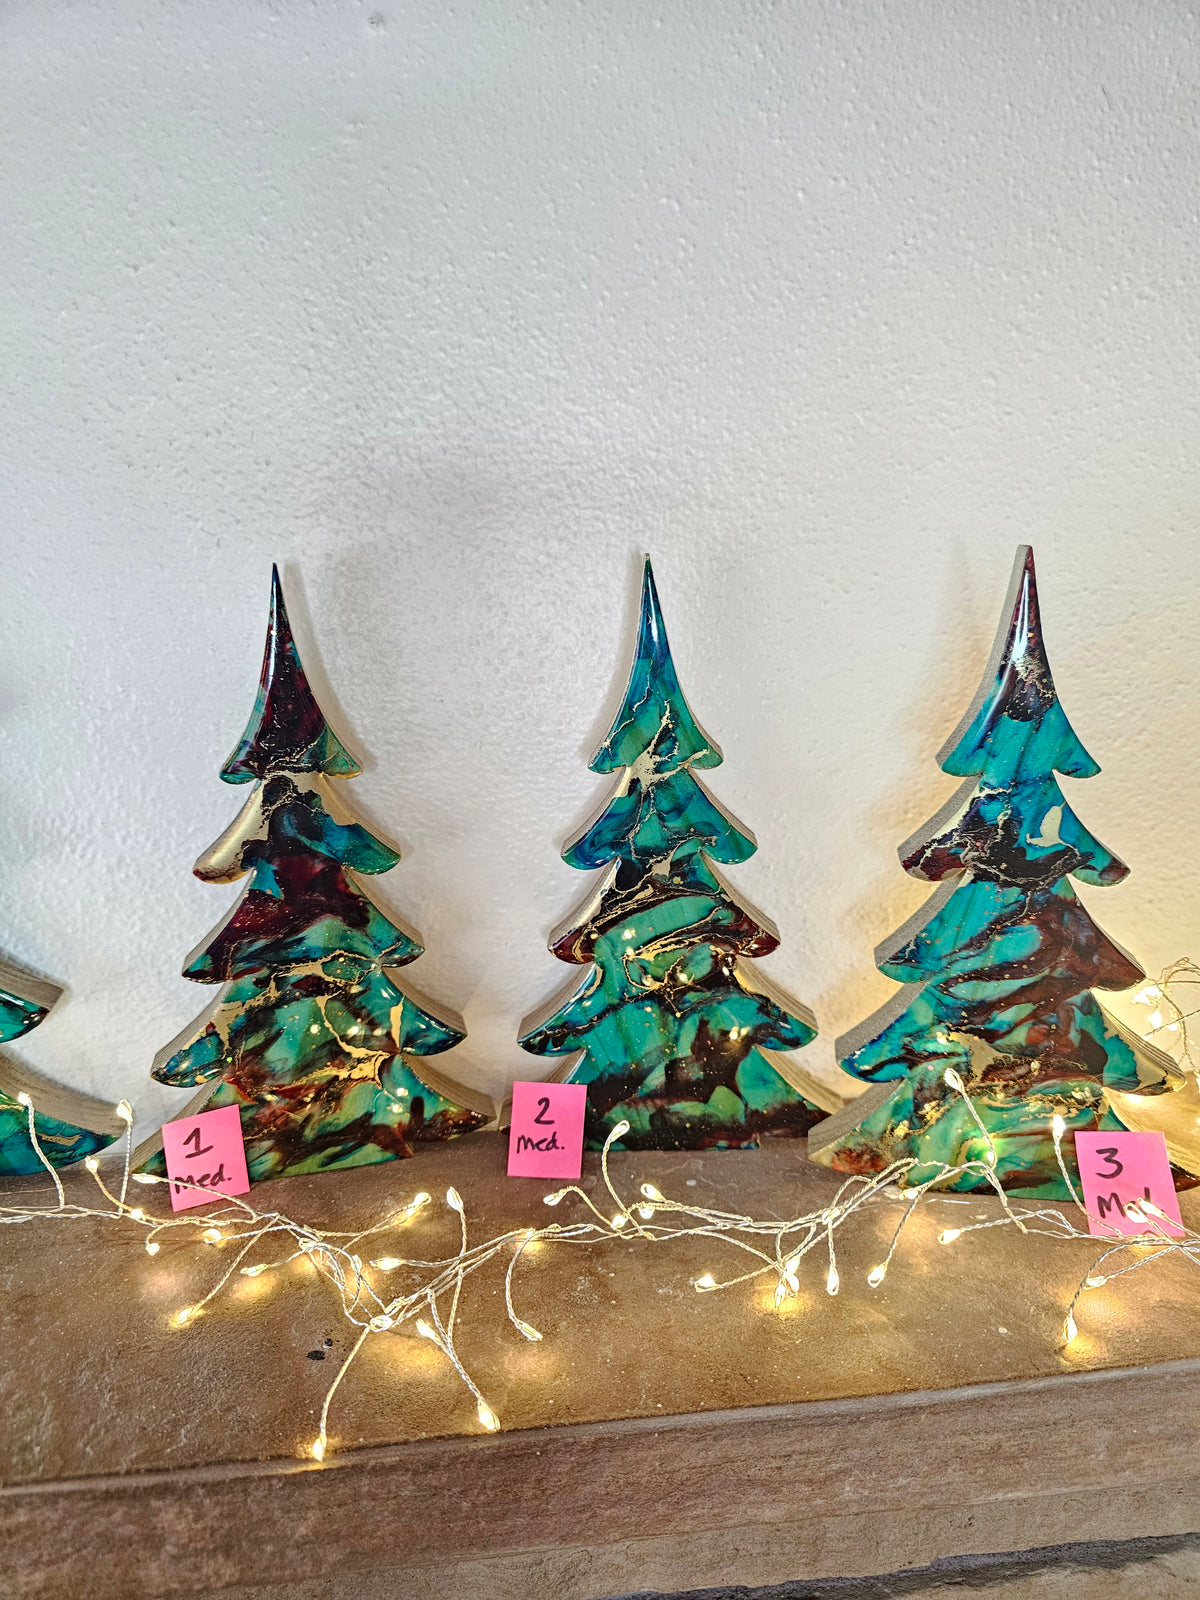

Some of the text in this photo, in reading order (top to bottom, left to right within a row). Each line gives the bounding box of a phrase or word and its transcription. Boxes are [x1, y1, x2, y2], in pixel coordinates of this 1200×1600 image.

[534, 1097, 555, 1125] 2
[183, 1127, 214, 1159] 1
[1095, 1147, 1123, 1179] 3
